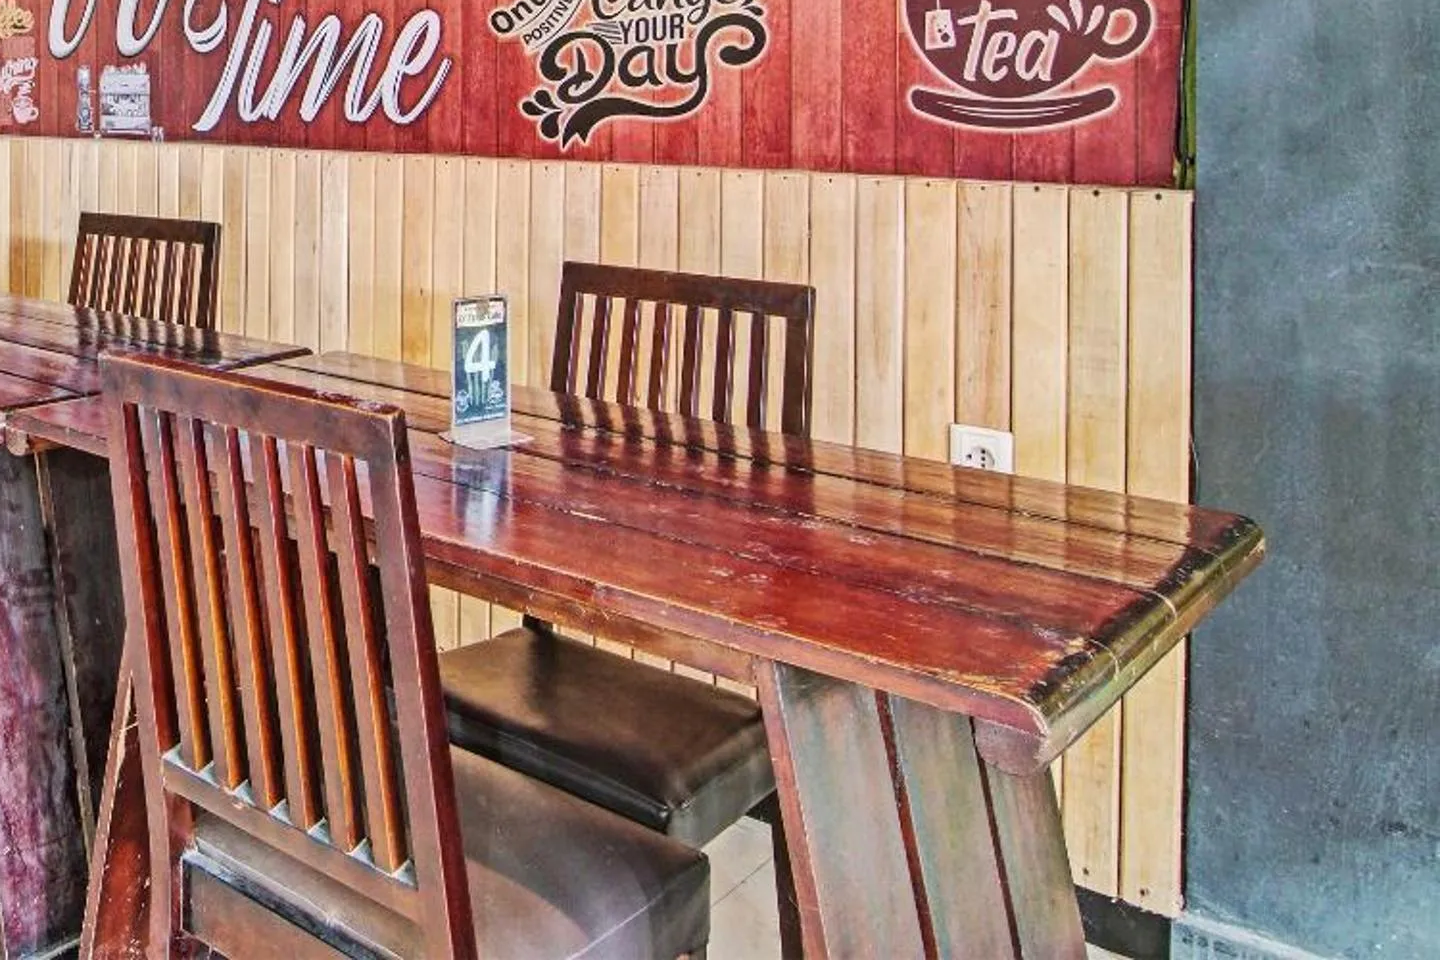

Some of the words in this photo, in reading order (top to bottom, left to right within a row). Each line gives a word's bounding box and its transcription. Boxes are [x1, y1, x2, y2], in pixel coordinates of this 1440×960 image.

[618, 14, 686, 45] YOUR
[956, 0, 1062, 83] tea
[539, 13, 767, 149] Day
[464, 329, 497, 383] 4
